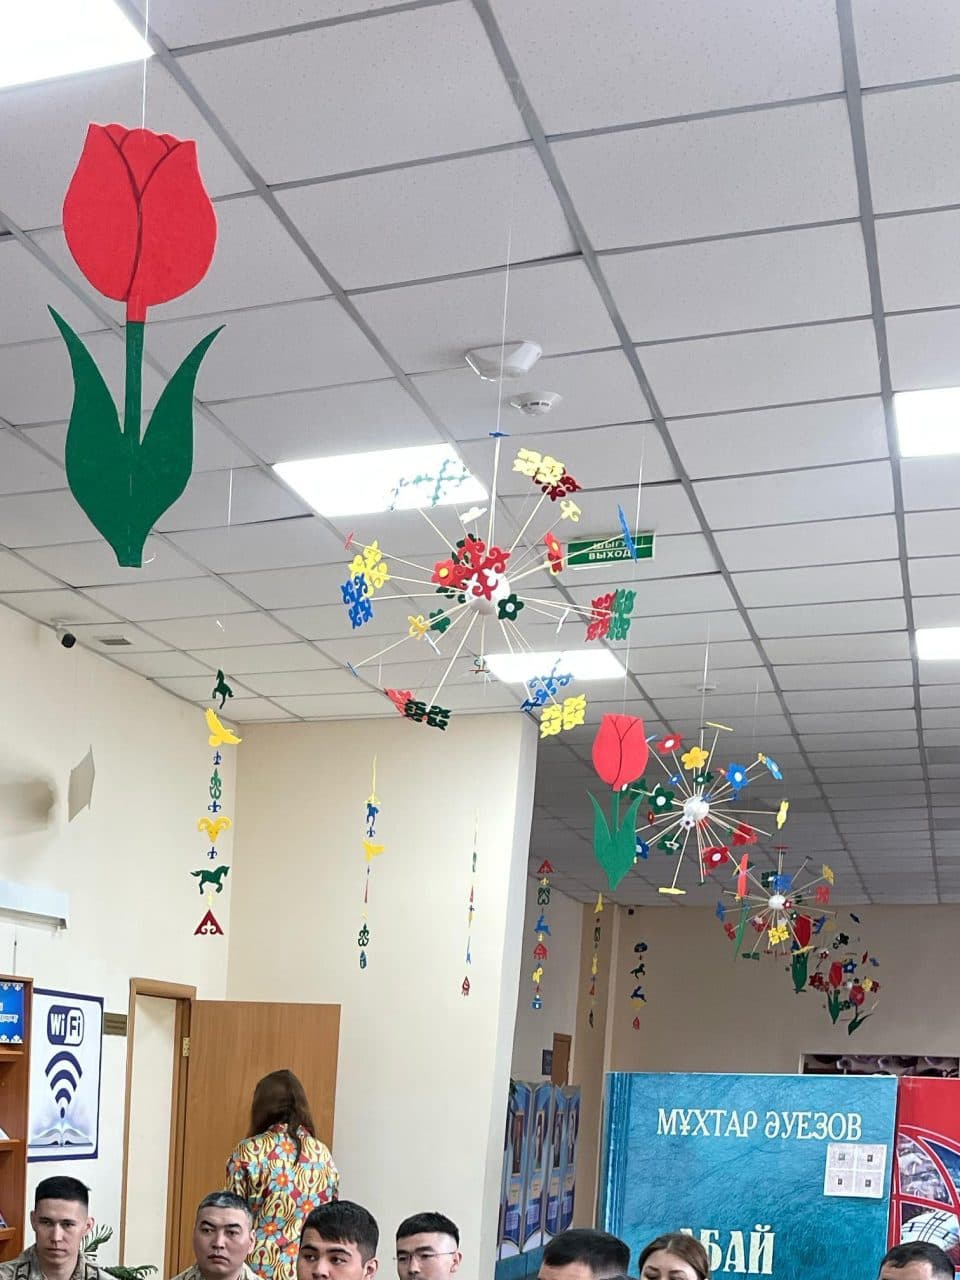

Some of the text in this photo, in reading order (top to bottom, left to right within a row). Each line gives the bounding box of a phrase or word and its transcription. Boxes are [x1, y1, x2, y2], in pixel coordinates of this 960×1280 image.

[589, 548, 632, 560] ВЫХОД
[656, 1108, 862, 1141] МҰХТАР ӘУЕЗОВ
[680, 1223, 776, 1275] БАЙ
